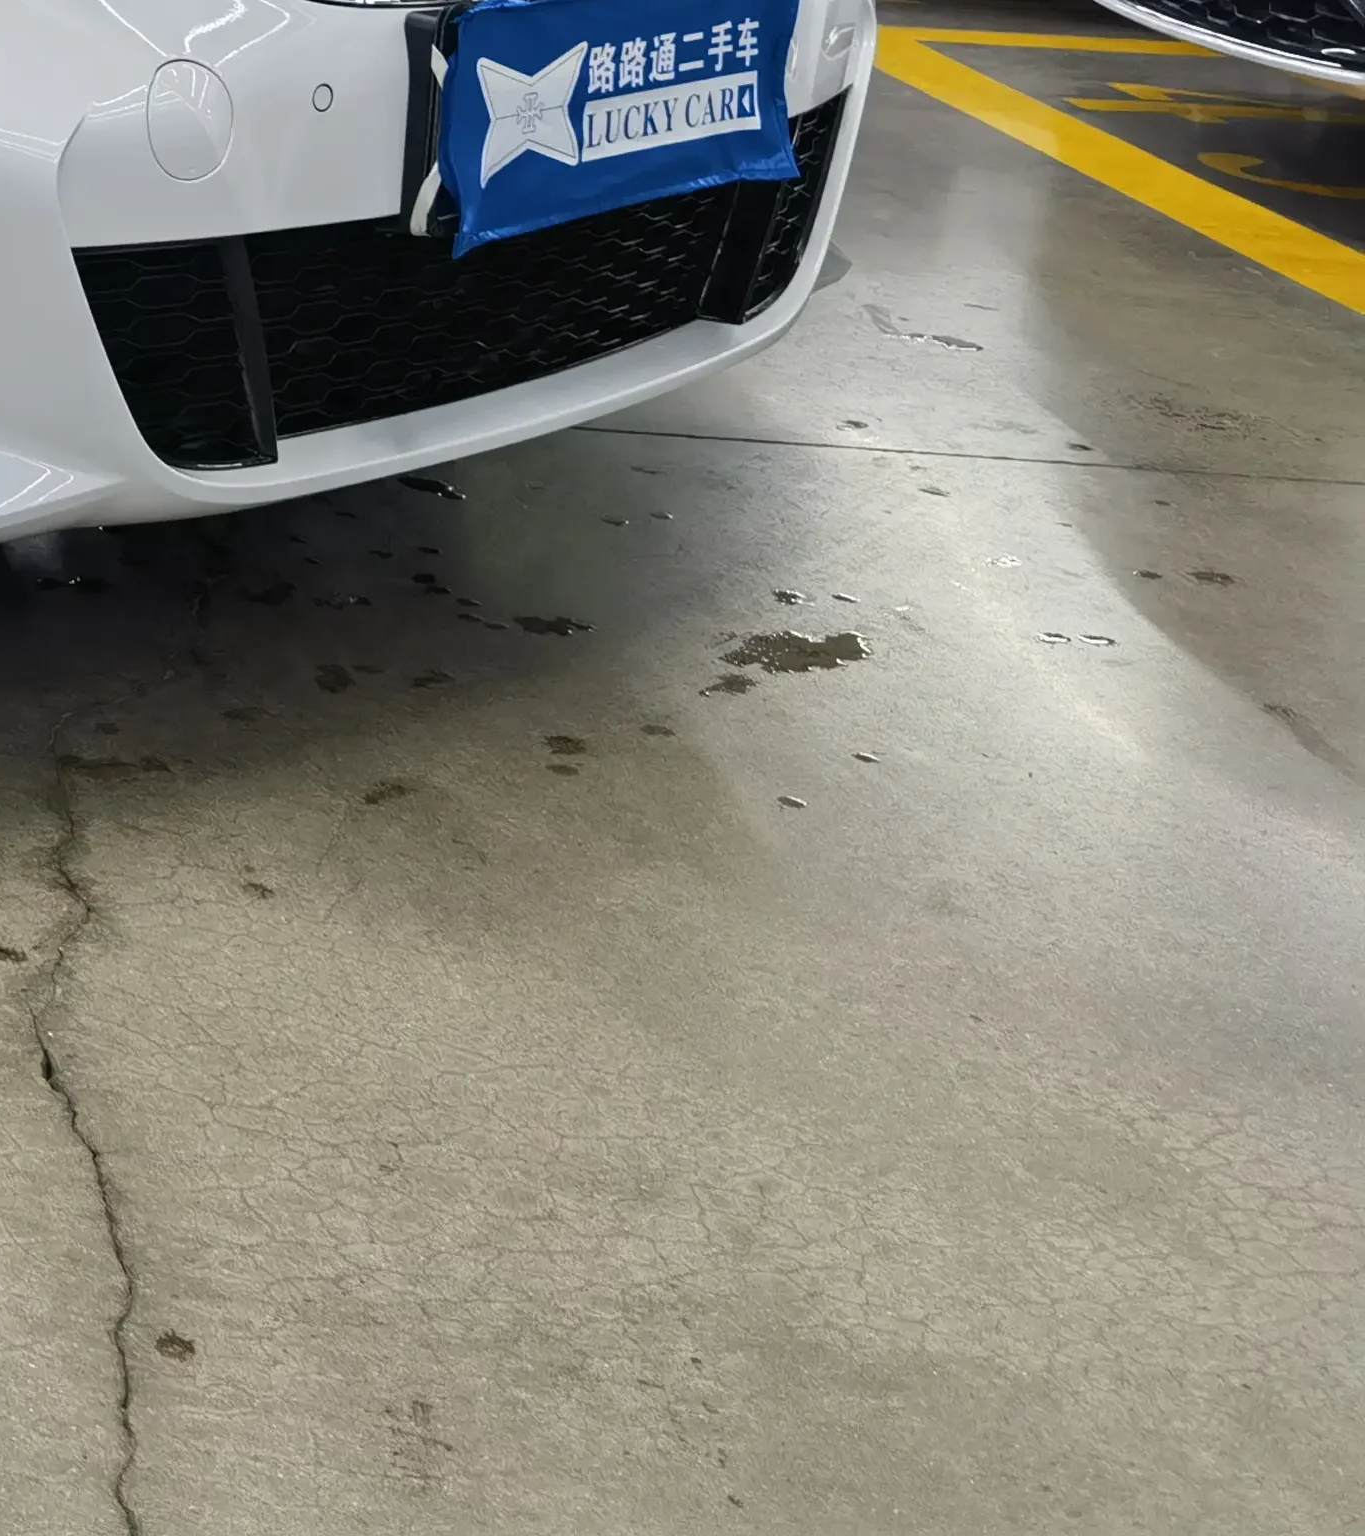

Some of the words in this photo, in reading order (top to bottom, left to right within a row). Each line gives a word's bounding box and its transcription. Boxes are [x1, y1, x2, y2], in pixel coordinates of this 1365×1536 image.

[587, 17, 760, 94] 路路通二手车
[586, 97, 678, 149] LUCKY
[685, 88, 735, 128] CAR
